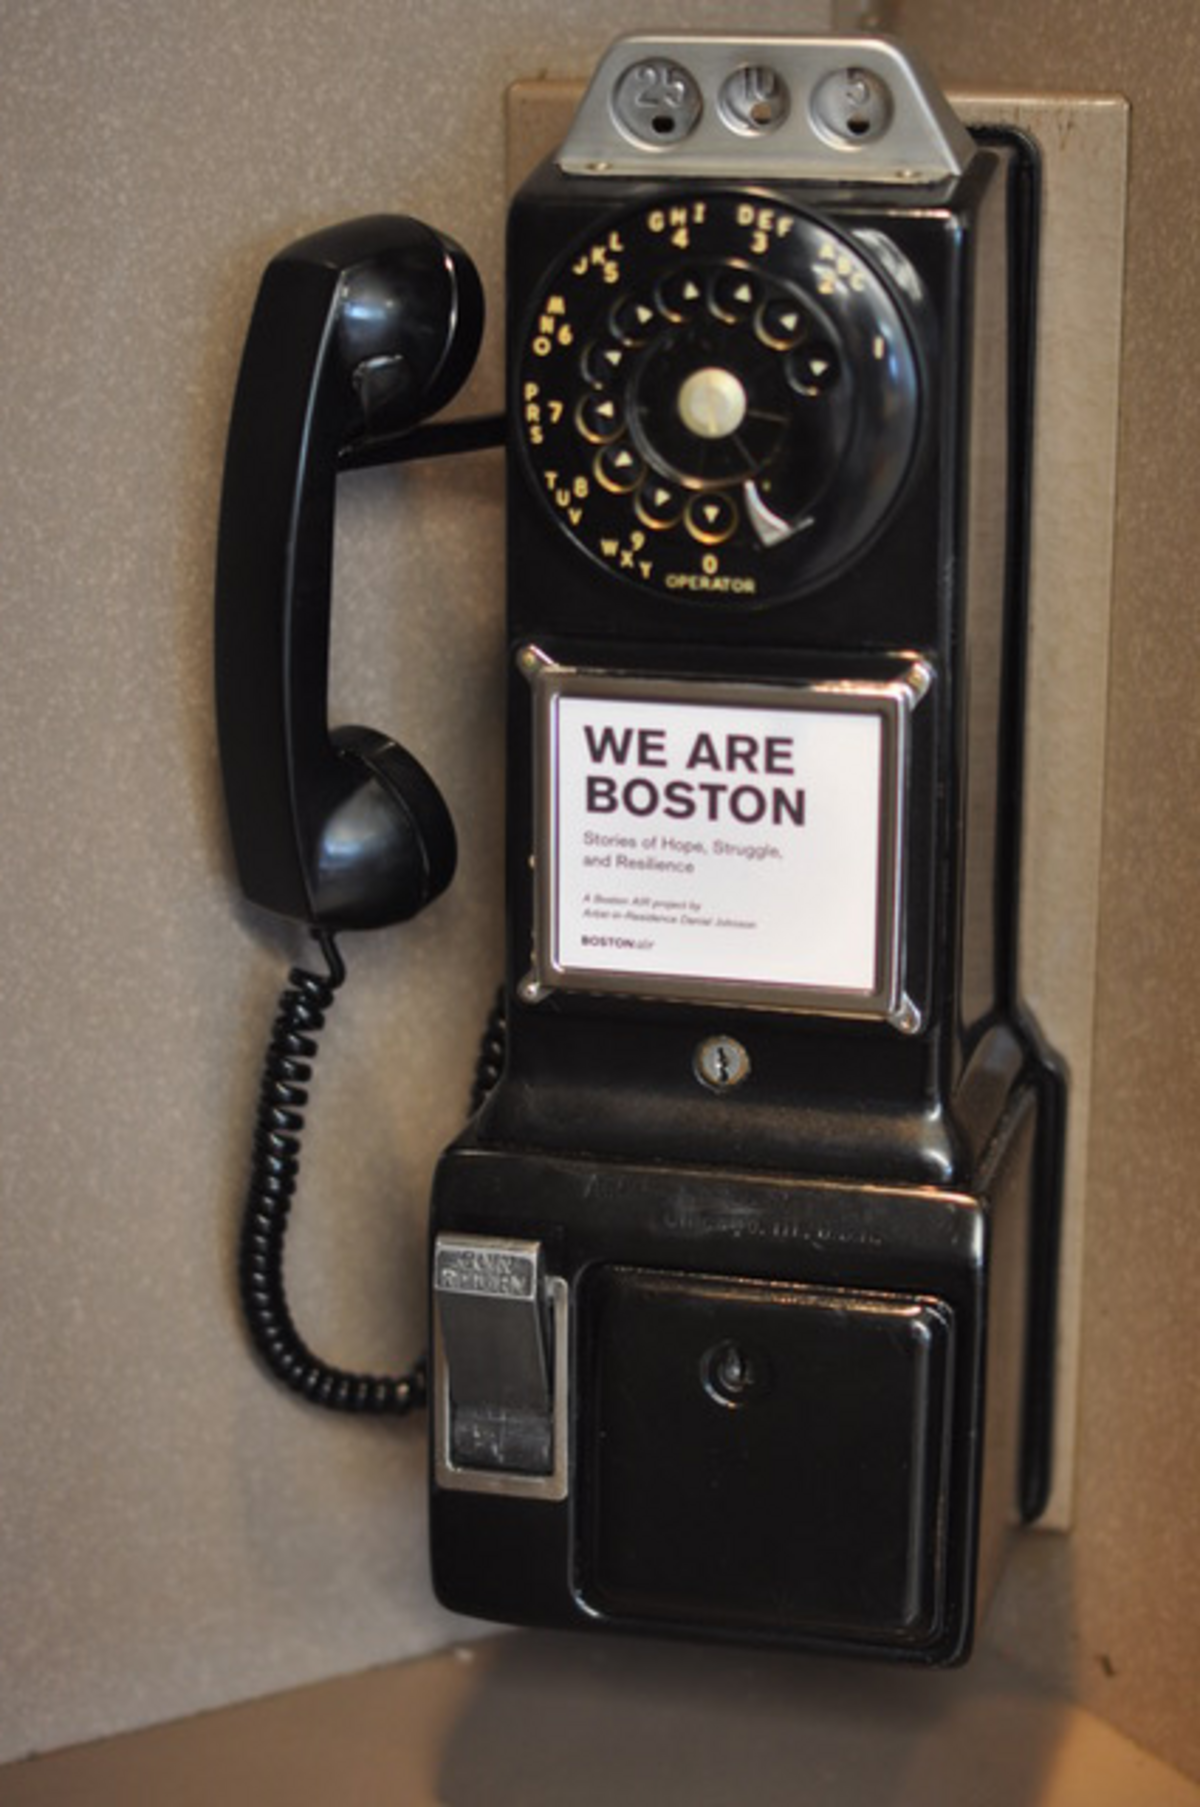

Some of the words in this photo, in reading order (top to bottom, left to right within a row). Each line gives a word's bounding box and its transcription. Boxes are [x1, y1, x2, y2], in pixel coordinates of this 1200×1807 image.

[635, 67, 686, 108] 25
[648, 202, 706, 232] GHI
[737, 204, 793, 237] DEF
[671, 228, 689, 249] 4
[751, 231, 768, 253] 3
[604, 261, 619, 284] 5
[557, 323, 573, 345] 6
[548, 401, 564, 424] 7
[573, 476, 589, 498] 8
[631, 531, 645, 552] 9
[702, 554, 718, 575] 0
[666, 575, 756, 594] OPERATOR
[584, 725, 668, 768] WE
[686, 732, 795, 775] ARE
[586, 775, 806, 827] BOSTON
[583, 831, 637, 849] Stories
[641, 836, 657, 850] of
[661, 837, 708, 856] Hope,
[712, 839, 784, 861] Struggle,
[583, 855, 611, 868] and
[615, 854, 695, 874] Resilience
[583, 894, 591, 903] A
[593, 894, 629, 905] Boston
[652, 899, 687, 911] project
[689, 902, 702, 912] by
